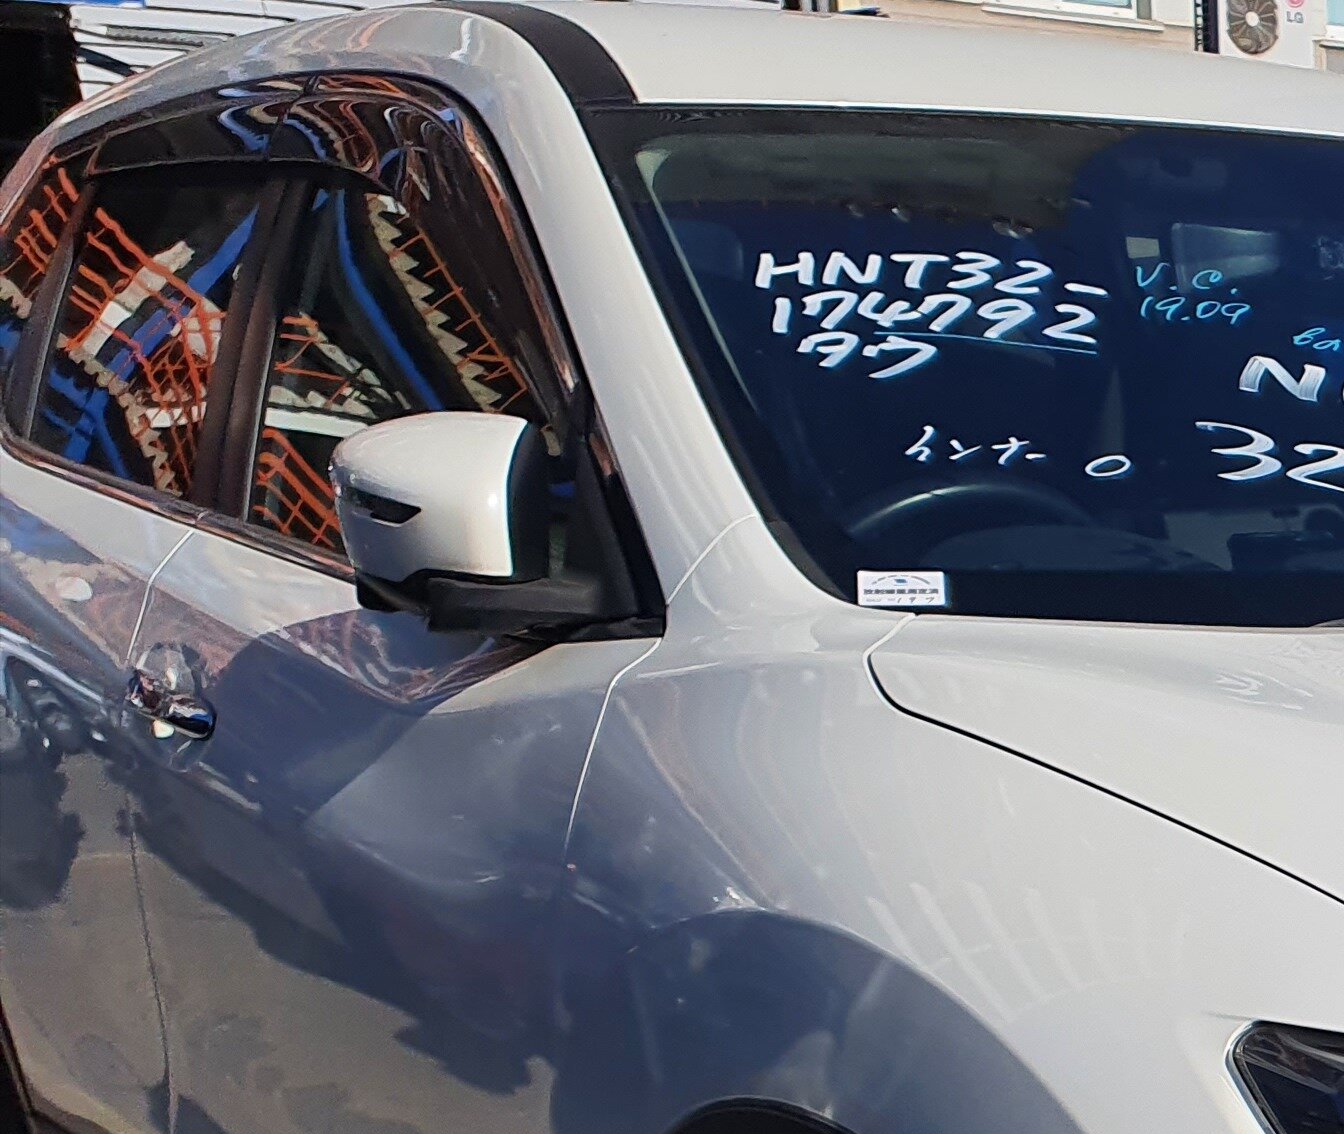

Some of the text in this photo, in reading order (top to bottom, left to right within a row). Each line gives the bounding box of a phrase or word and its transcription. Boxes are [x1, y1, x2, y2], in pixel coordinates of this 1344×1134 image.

[1286, 11, 1304, 23] LG
[772, 291, 1098, 344] 174792
[1140, 296, 1253, 325] 19.09
